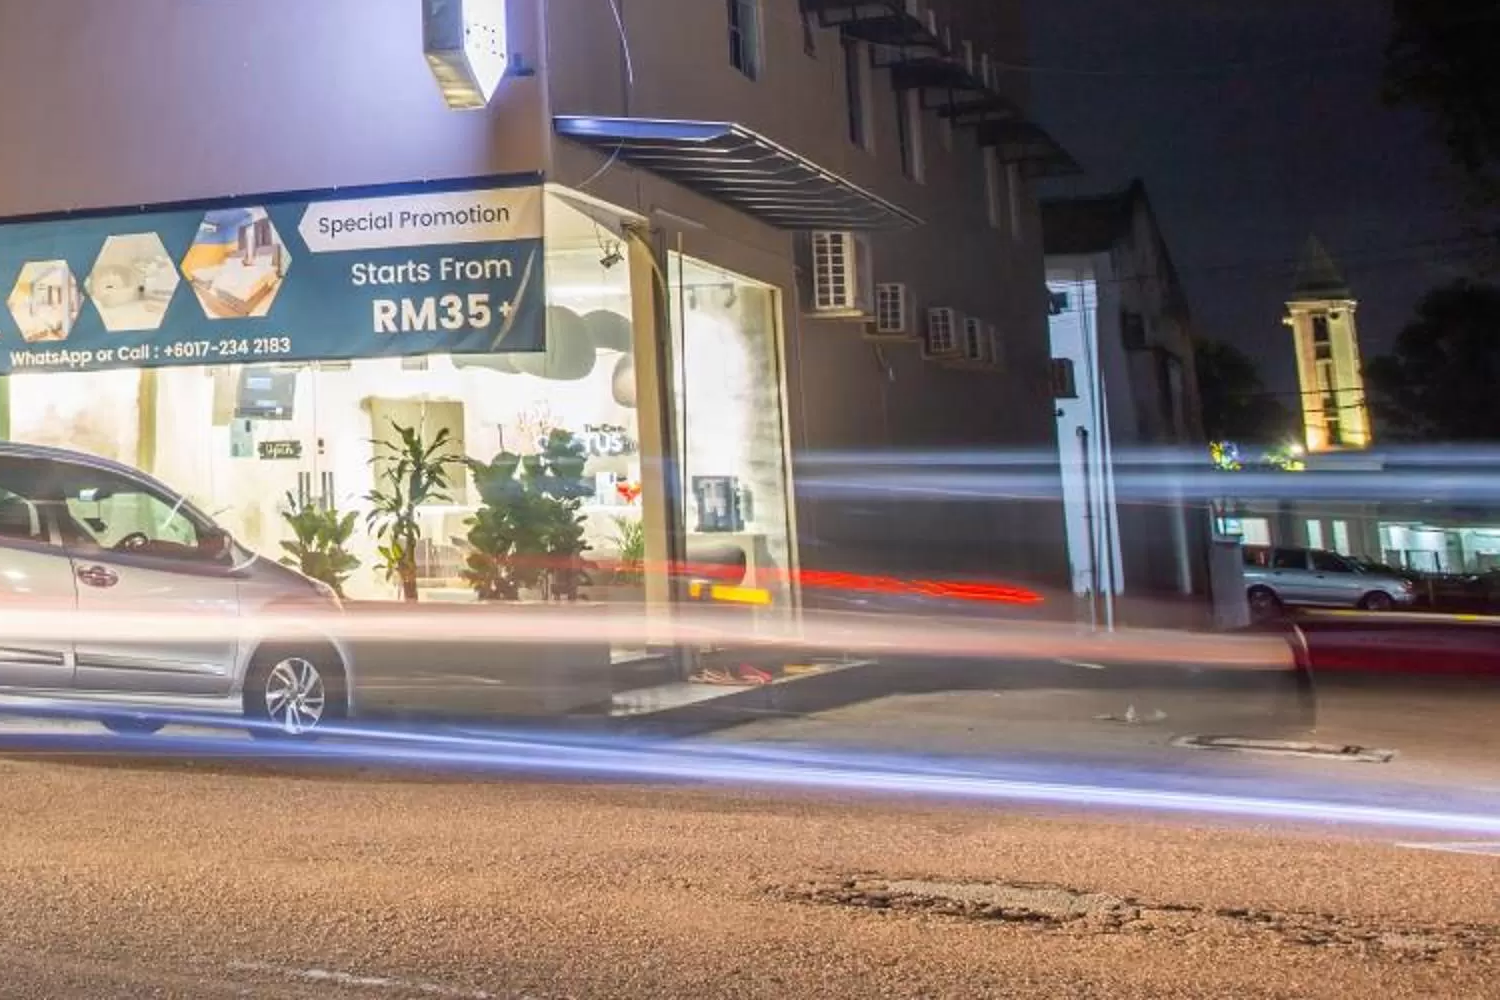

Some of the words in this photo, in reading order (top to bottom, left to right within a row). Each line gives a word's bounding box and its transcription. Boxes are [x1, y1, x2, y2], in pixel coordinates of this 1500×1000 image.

[318, 211, 393, 238] Special
[399, 205, 510, 229] Promotion
[351, 259, 431, 286] Starts
[440, 256, 513, 282] From
[10, 349, 92, 368] WhatsApp
[97, 350, 113, 362] or
[117, 344, 150, 361] Call
[163, 339, 249, 359] +6017-234
[253, 337, 292, 355] 2183
